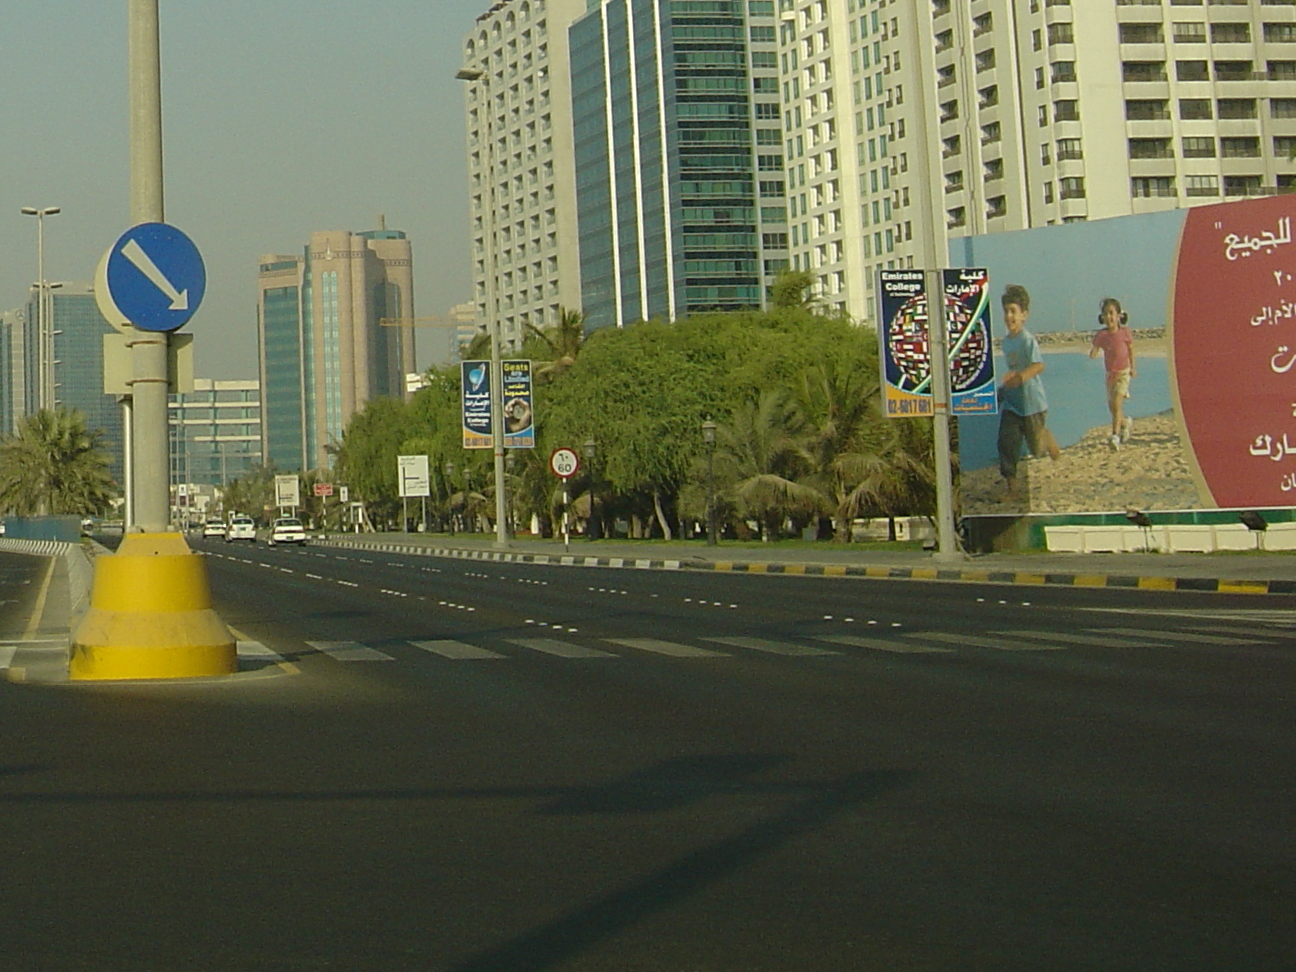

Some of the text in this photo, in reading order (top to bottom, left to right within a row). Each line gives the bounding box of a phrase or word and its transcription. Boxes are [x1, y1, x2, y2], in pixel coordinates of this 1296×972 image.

[881, 272, 923, 280] Emirates
[959, 269, 985, 283] كلية
[885, 282, 921, 291] College
[558, 463, 572, 472] 60
